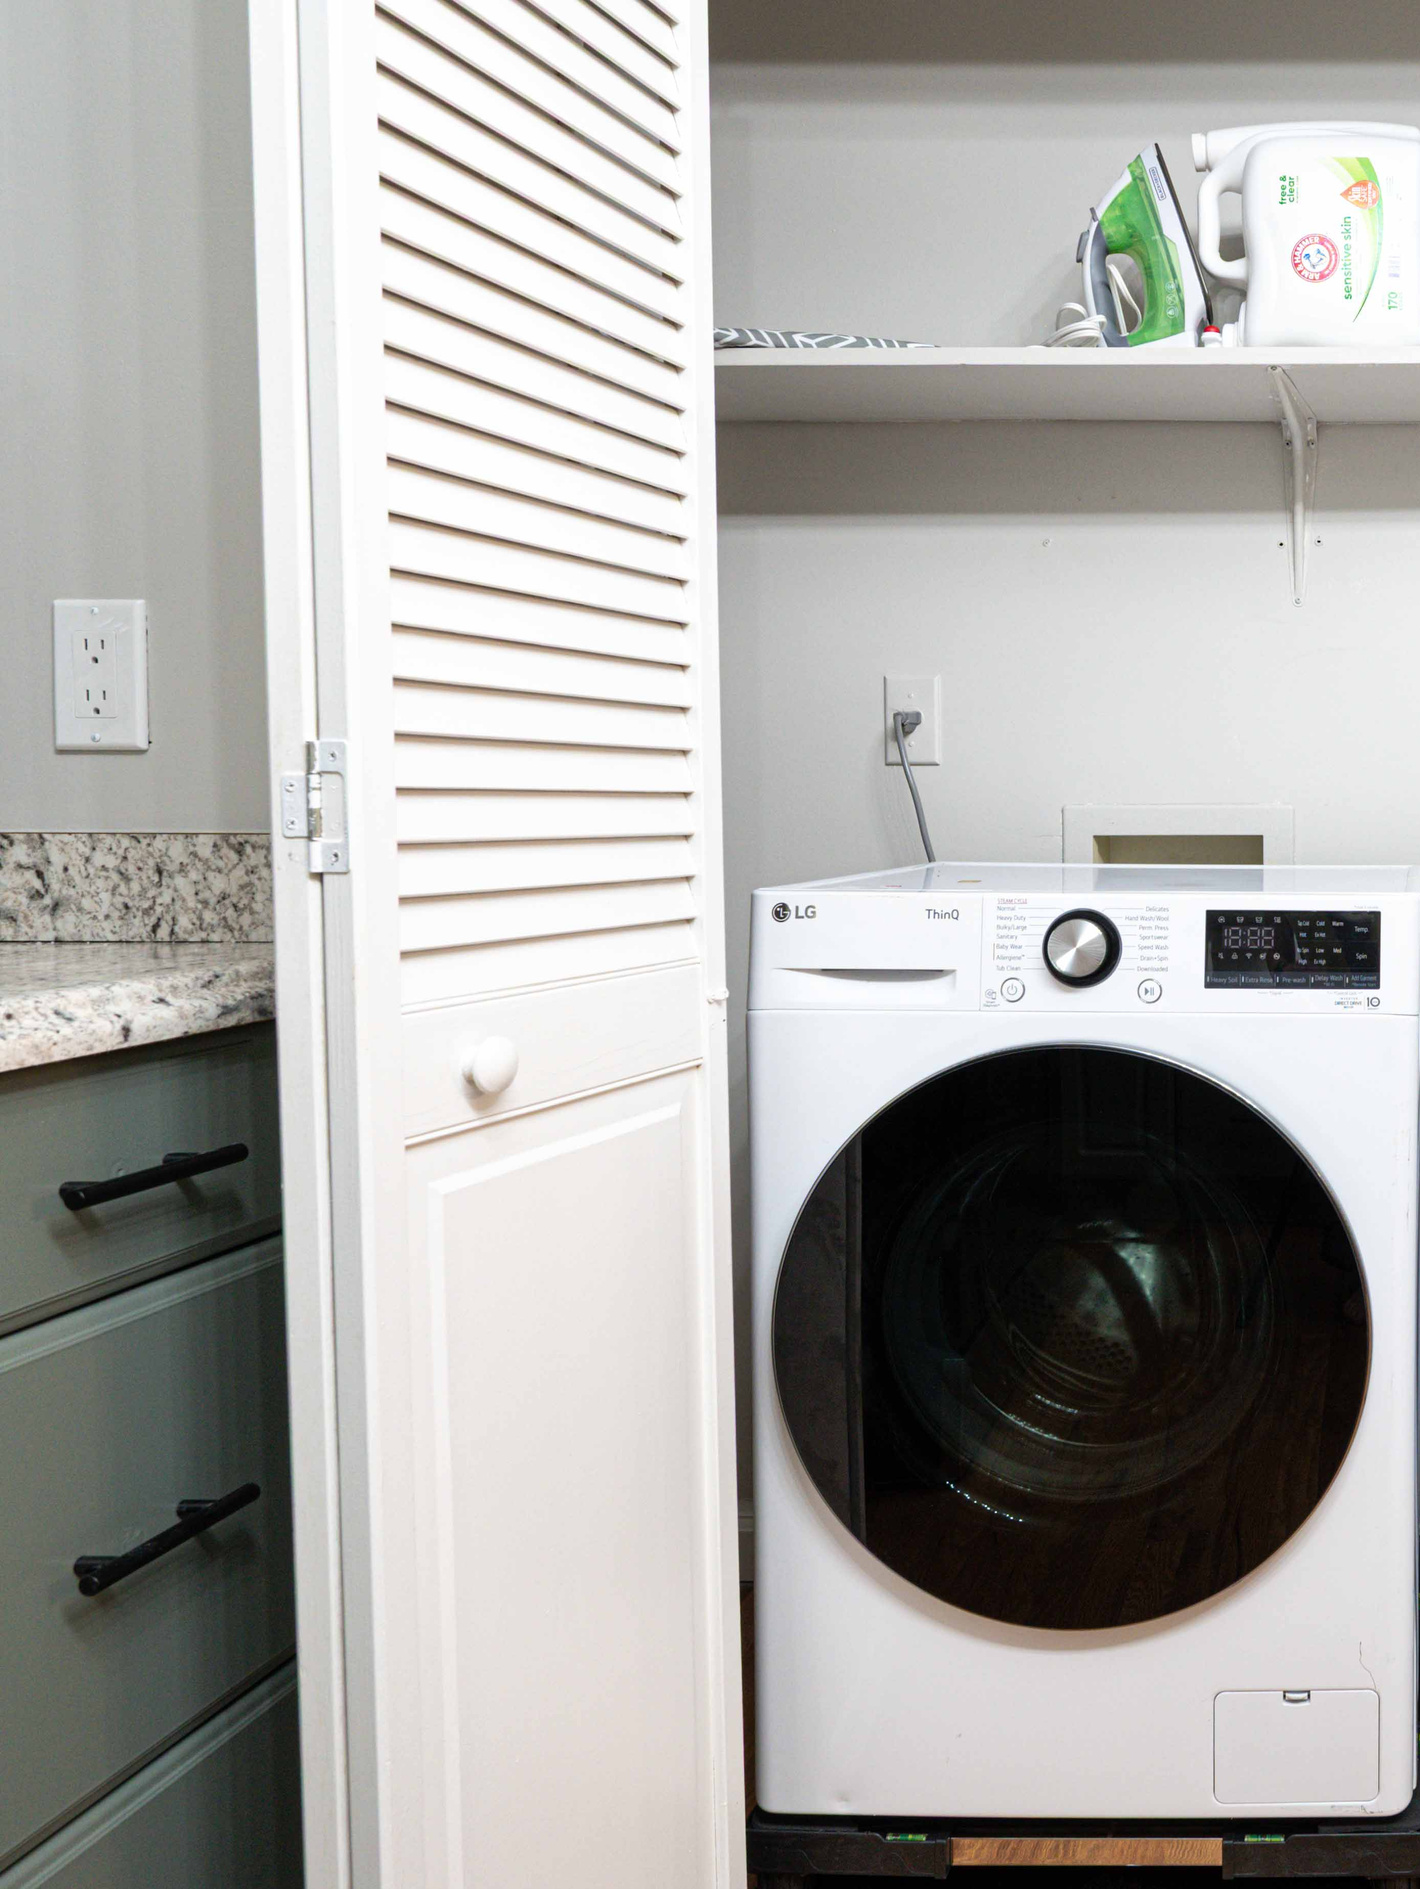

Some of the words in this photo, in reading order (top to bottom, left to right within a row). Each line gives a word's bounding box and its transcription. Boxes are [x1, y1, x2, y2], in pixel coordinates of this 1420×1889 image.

[1279, 184, 1287, 205] free
[1287, 177, 1295, 203] clear
[1341, 216, 1352, 240] skin
[1294, 236, 1320, 263] HAMMER
[1301, 269, 1320, 280] ARM
[1341, 243, 1352, 300] sensitive
[1388, 292, 1398, 310] 170
[794, 905, 817, 919] LG
[925, 908, 960, 920] ThinQ
[1211, 976, 1227, 984] Heavy
